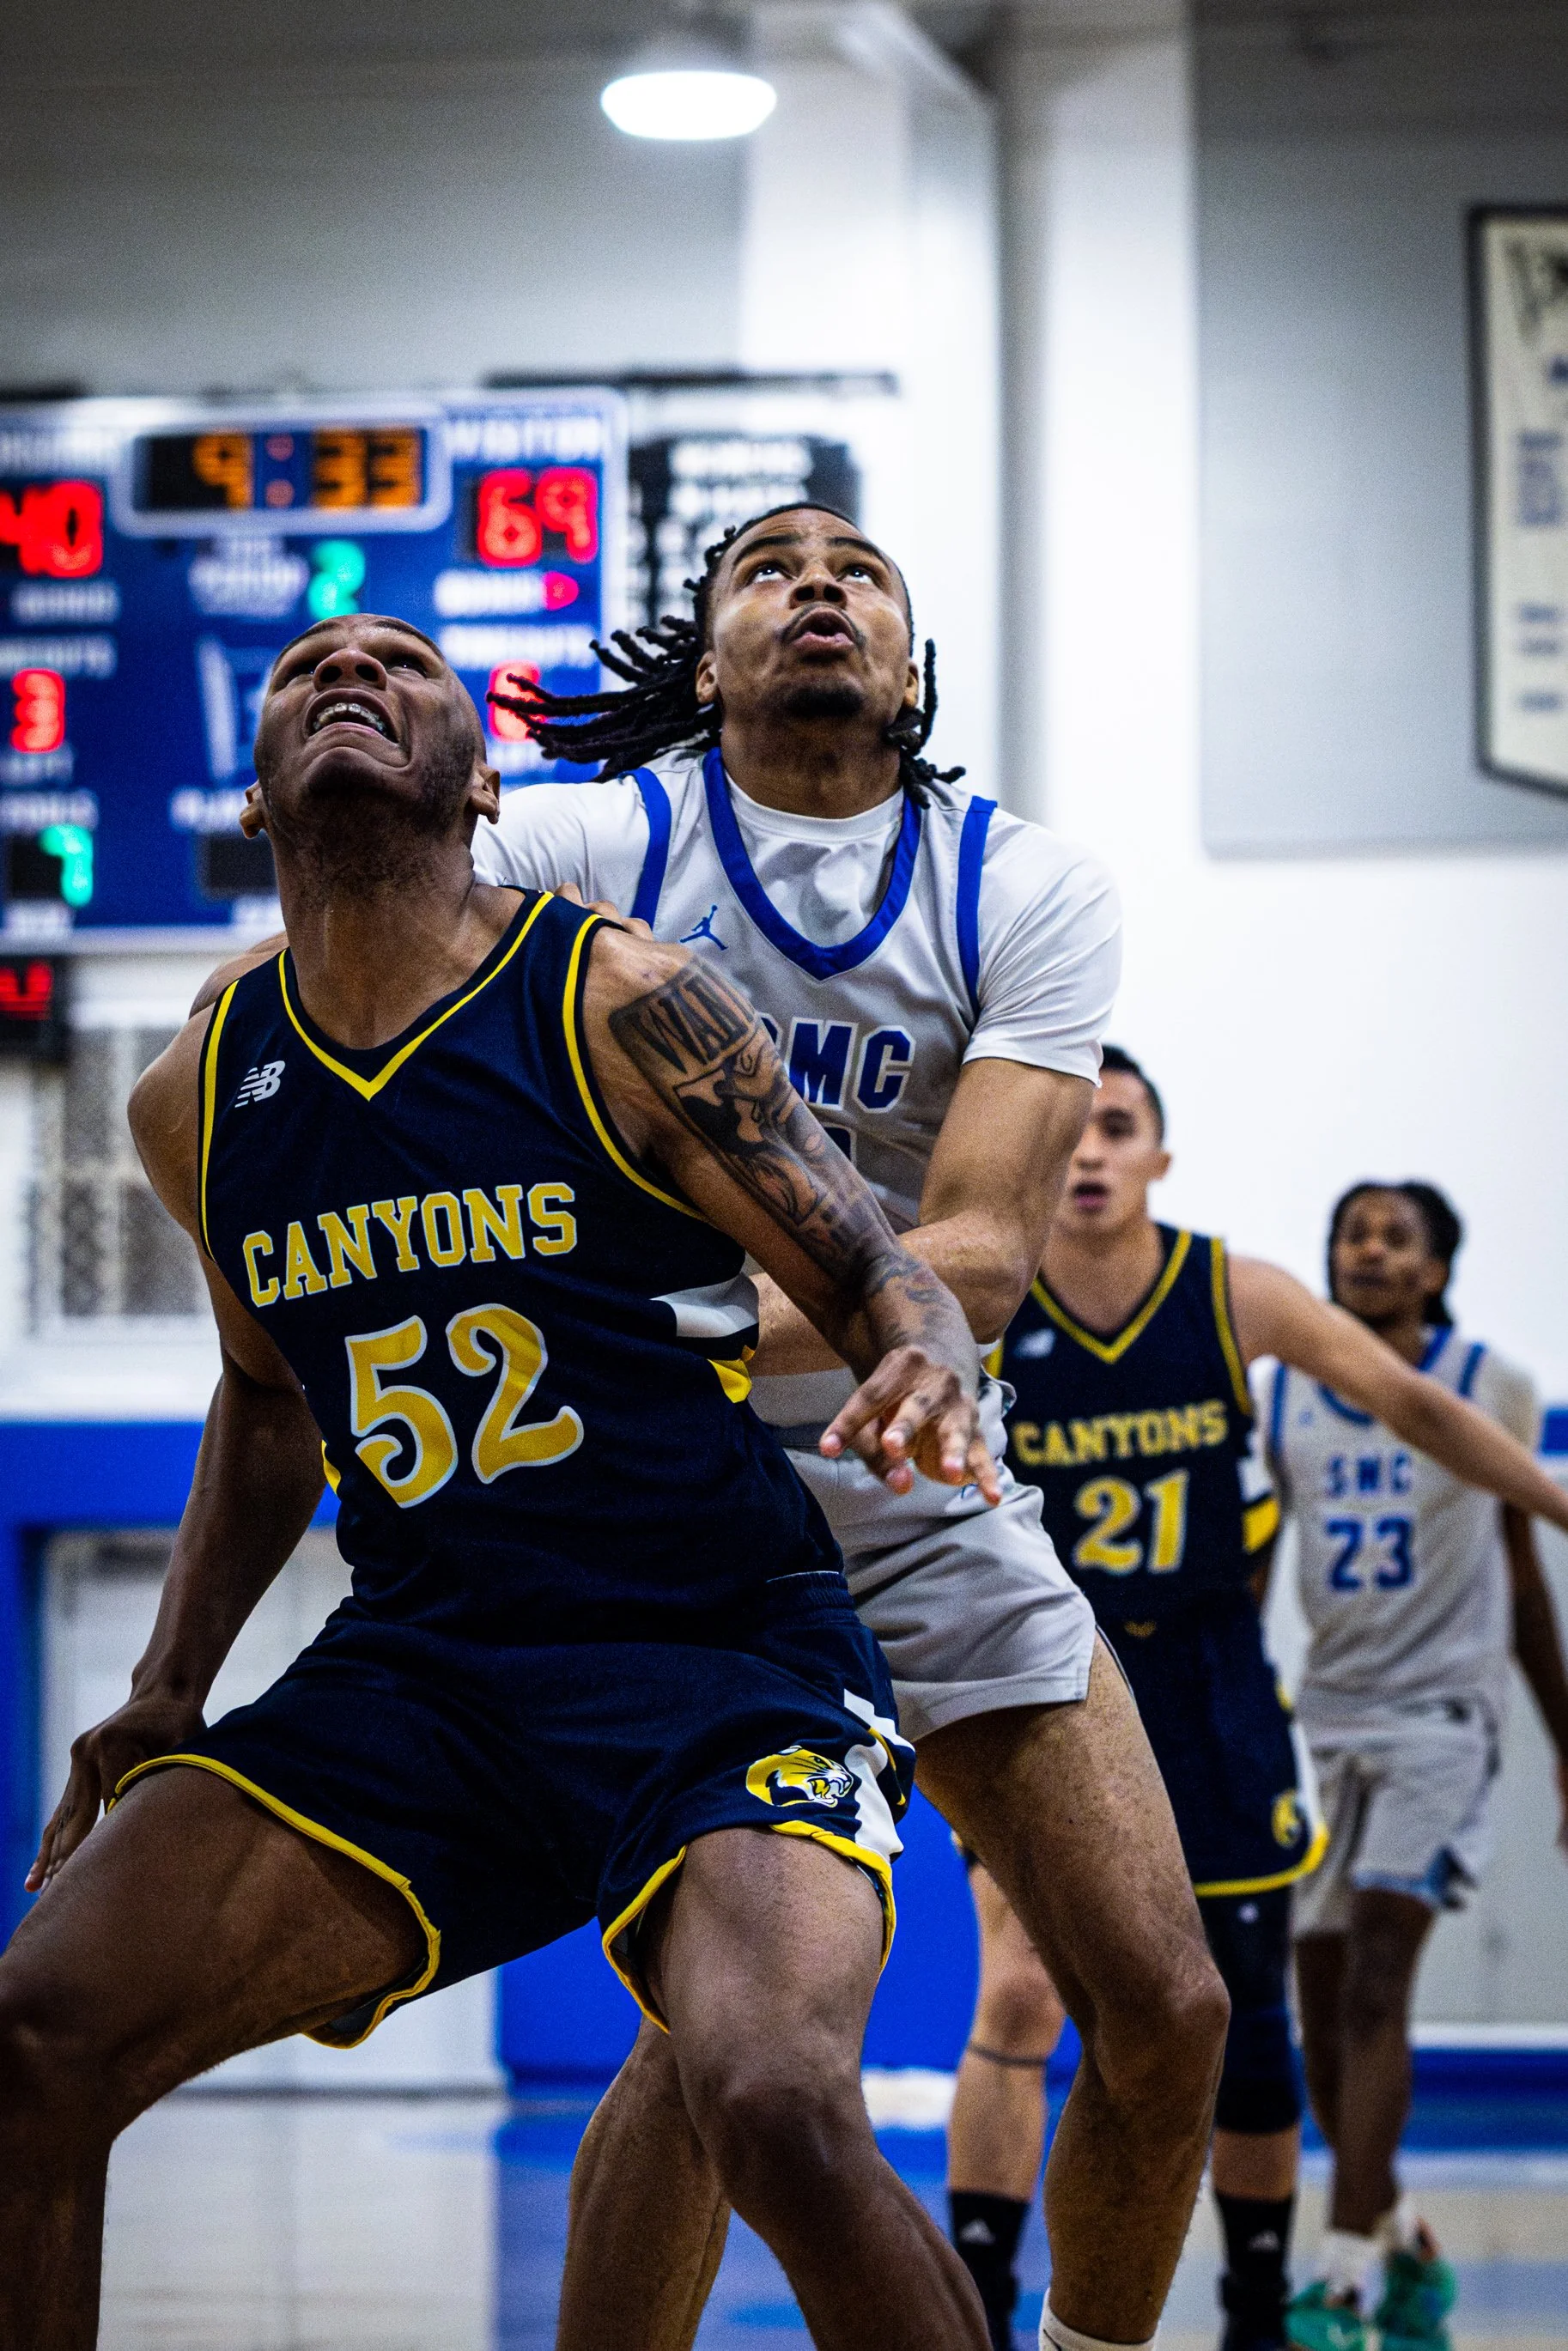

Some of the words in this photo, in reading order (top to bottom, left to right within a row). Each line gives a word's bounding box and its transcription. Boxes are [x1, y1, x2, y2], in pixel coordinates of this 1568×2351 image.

[192, 431, 421, 512] 9:33
[477, 468, 599, 567] 69
[759, 1011, 916, 1115] MC
[242, 1182, 577, 1308] CANYONS
[345, 1303, 584, 1509] 52
[1012, 1399, 1228, 1466] CANYONS
[1073, 1467, 1190, 1576] 21
[1325, 1516, 1413, 1590] 23
